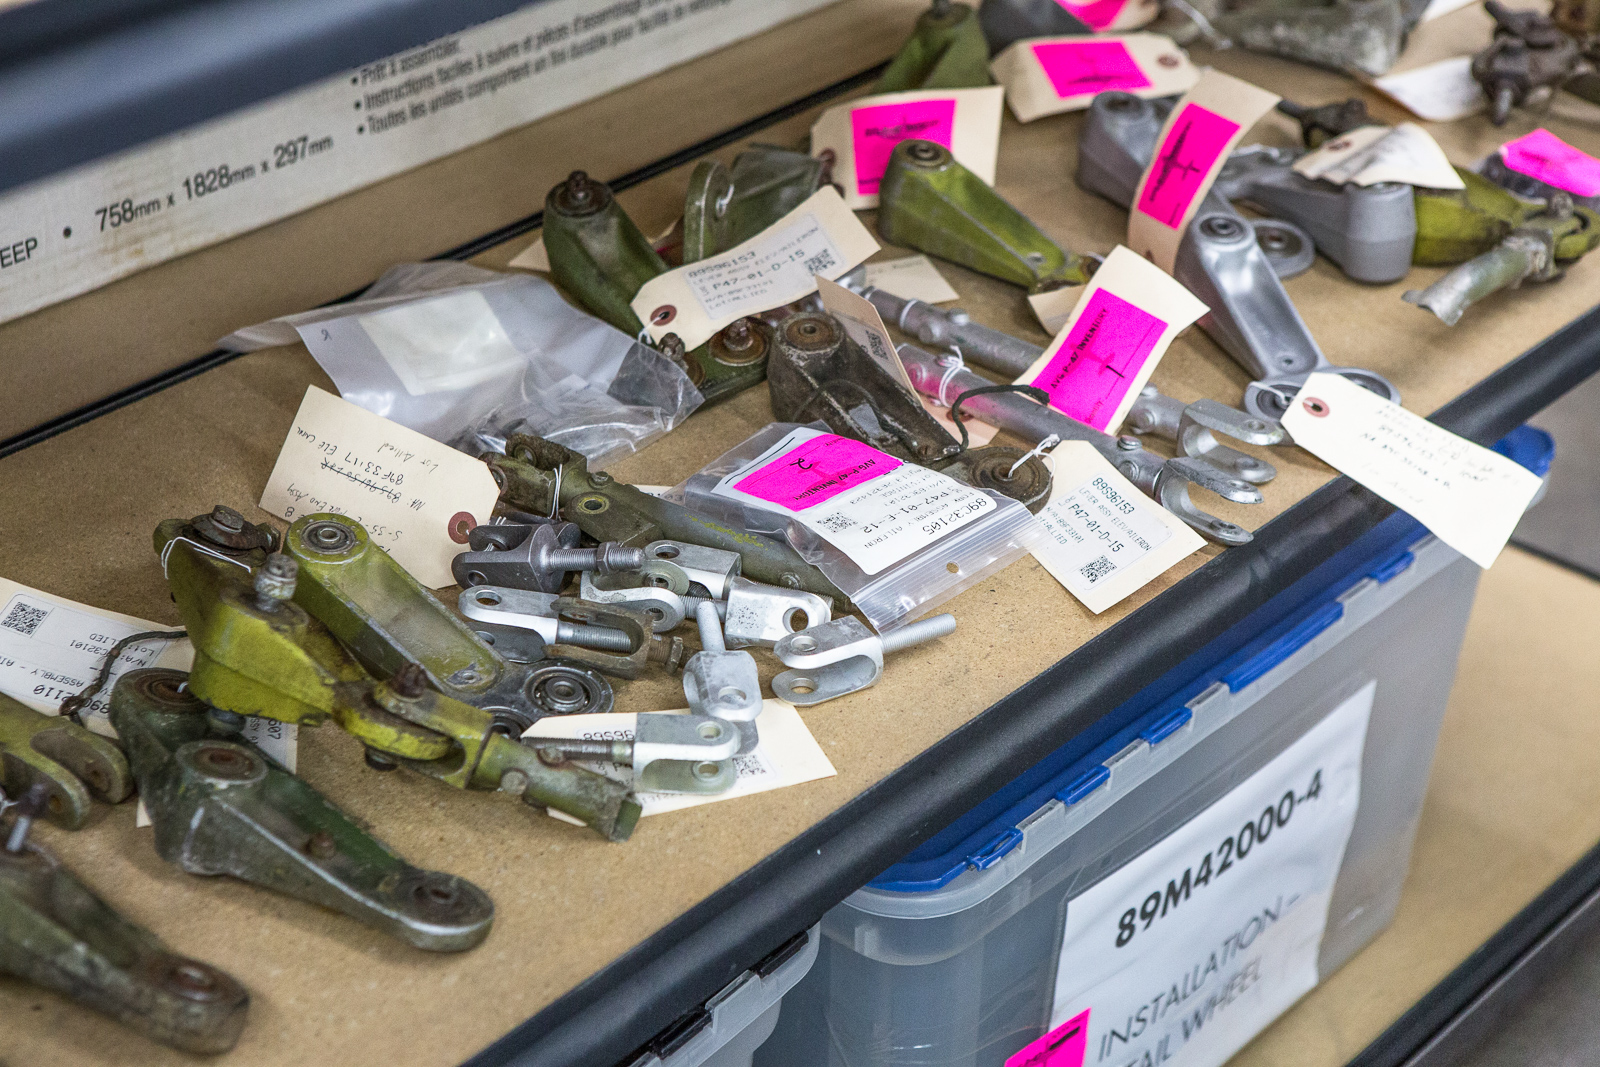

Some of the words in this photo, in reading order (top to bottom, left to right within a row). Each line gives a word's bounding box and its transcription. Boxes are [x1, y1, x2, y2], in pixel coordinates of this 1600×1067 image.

[364, 72, 435, 111] Instructions
[368, 107, 407, 135] Toutes
[408, 99, 427, 120] les
[465, 60, 531, 95] comportent
[95, 198, 161, 232] 758mm
[166, 194, 175, 207] x
[182, 164, 256, 200] 1828mm
[260, 160, 269, 173] x
[273, 135, 333, 168] 297mm
[713, 249, 805, 291] P47-01-D-15
[1050, 372, 1066, 389] AVG
[1062, 350, 1079, 374] P-47
[1076, 308, 1108, 354] INVENTORY
[789, 456, 813, 470] 2
[838, 467, 860, 481] P-47
[859, 459, 876, 471] AVG
[793, 477, 838, 501] INVENTORY
[1092, 477, 1135, 515] 89S96153
[861, 490, 949, 534] P47-01-E-12
[922, 497, 988, 536] 89C32105
[1036, 515, 1068, 545] ot:ALLIED
[1045, 506, 1085, 544] N/A:89F33101
[1068, 503, 1125, 553] P47-01-D-15
[1078, 487, 1099, 506] LEVER
[1097, 505, 1113, 521] ASSY
[1111, 517, 1152, 551] ELEV/AILERON
[864, 526, 903, 549] AILERON
[0, 656, 15, 667] AI
[69, 639, 146, 667] N/A:C32101
[30, 668, 84, 689] ASSEMBLY
[1115, 768, 1323, 948] 89M42000-4
[1099, 896, 1283, 1062] INSTALLATION
[1182, 956, 1262, 1043] WHEEL
